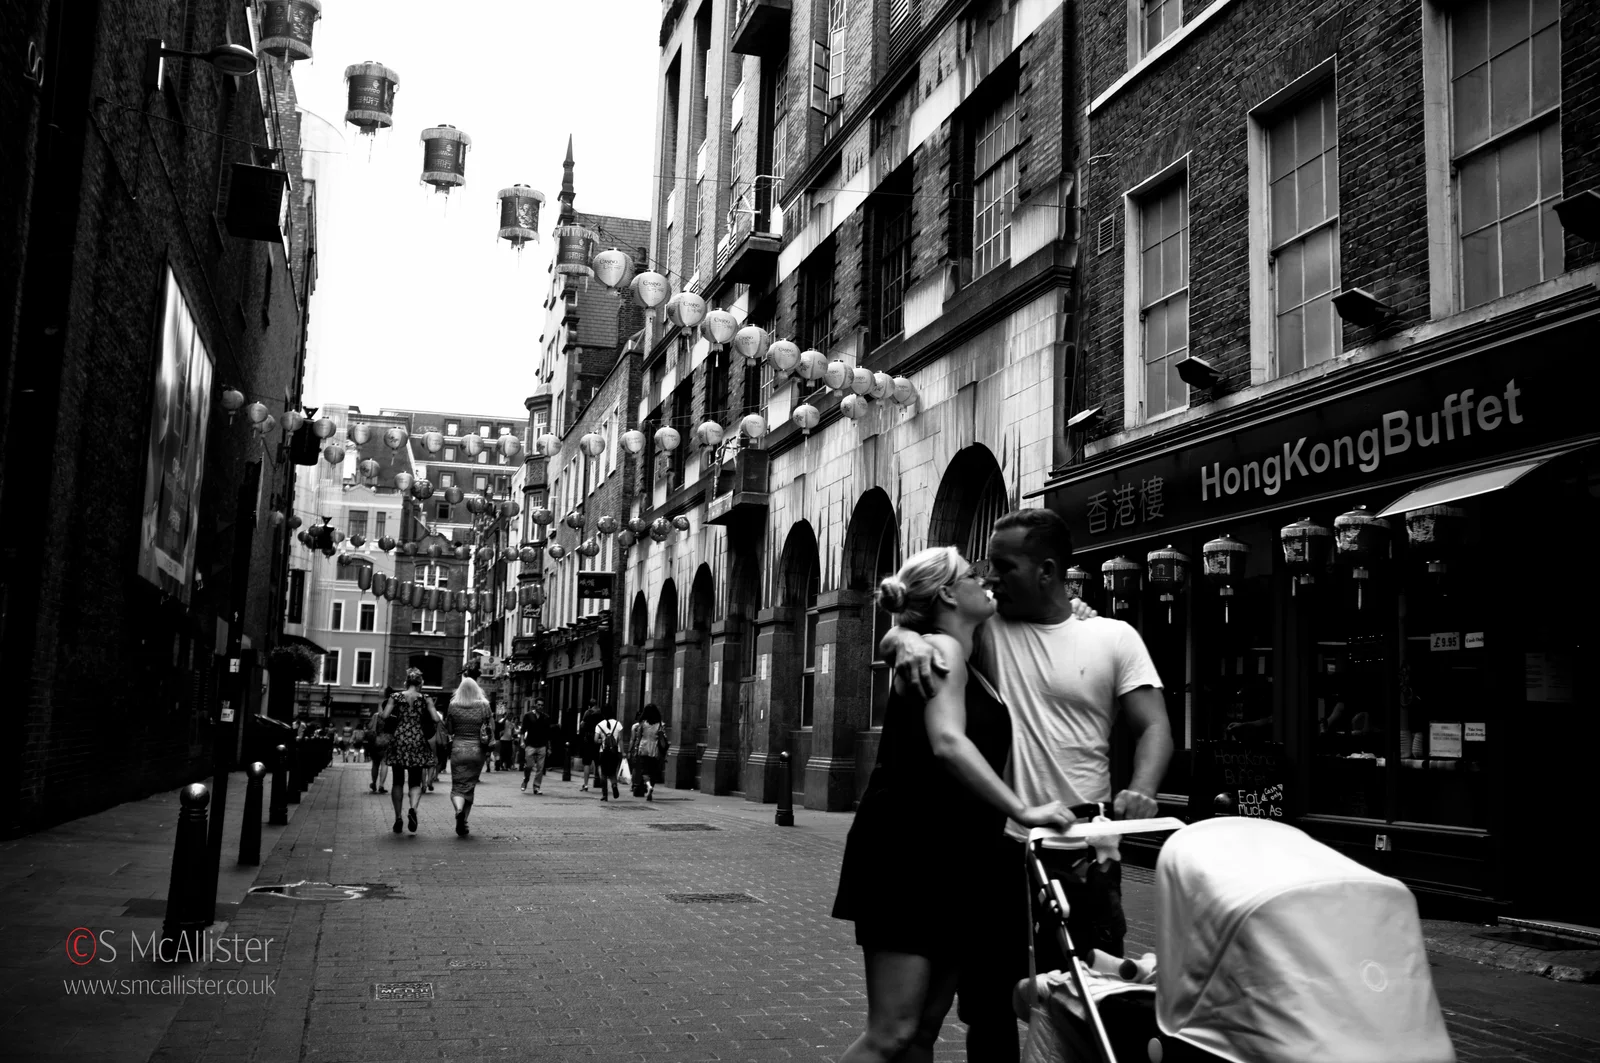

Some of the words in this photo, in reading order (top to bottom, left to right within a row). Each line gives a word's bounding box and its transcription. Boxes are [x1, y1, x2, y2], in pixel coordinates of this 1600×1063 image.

[1201, 379, 1524, 502] HongKongBuffet
[1085, 475, 1165, 535] 香港樓
[1433, 636, 1457, 648] £9.95
[1237, 789, 1262, 805] Eat
[1237, 803, 1266, 816] Much
[1269, 804, 1283, 817] As
